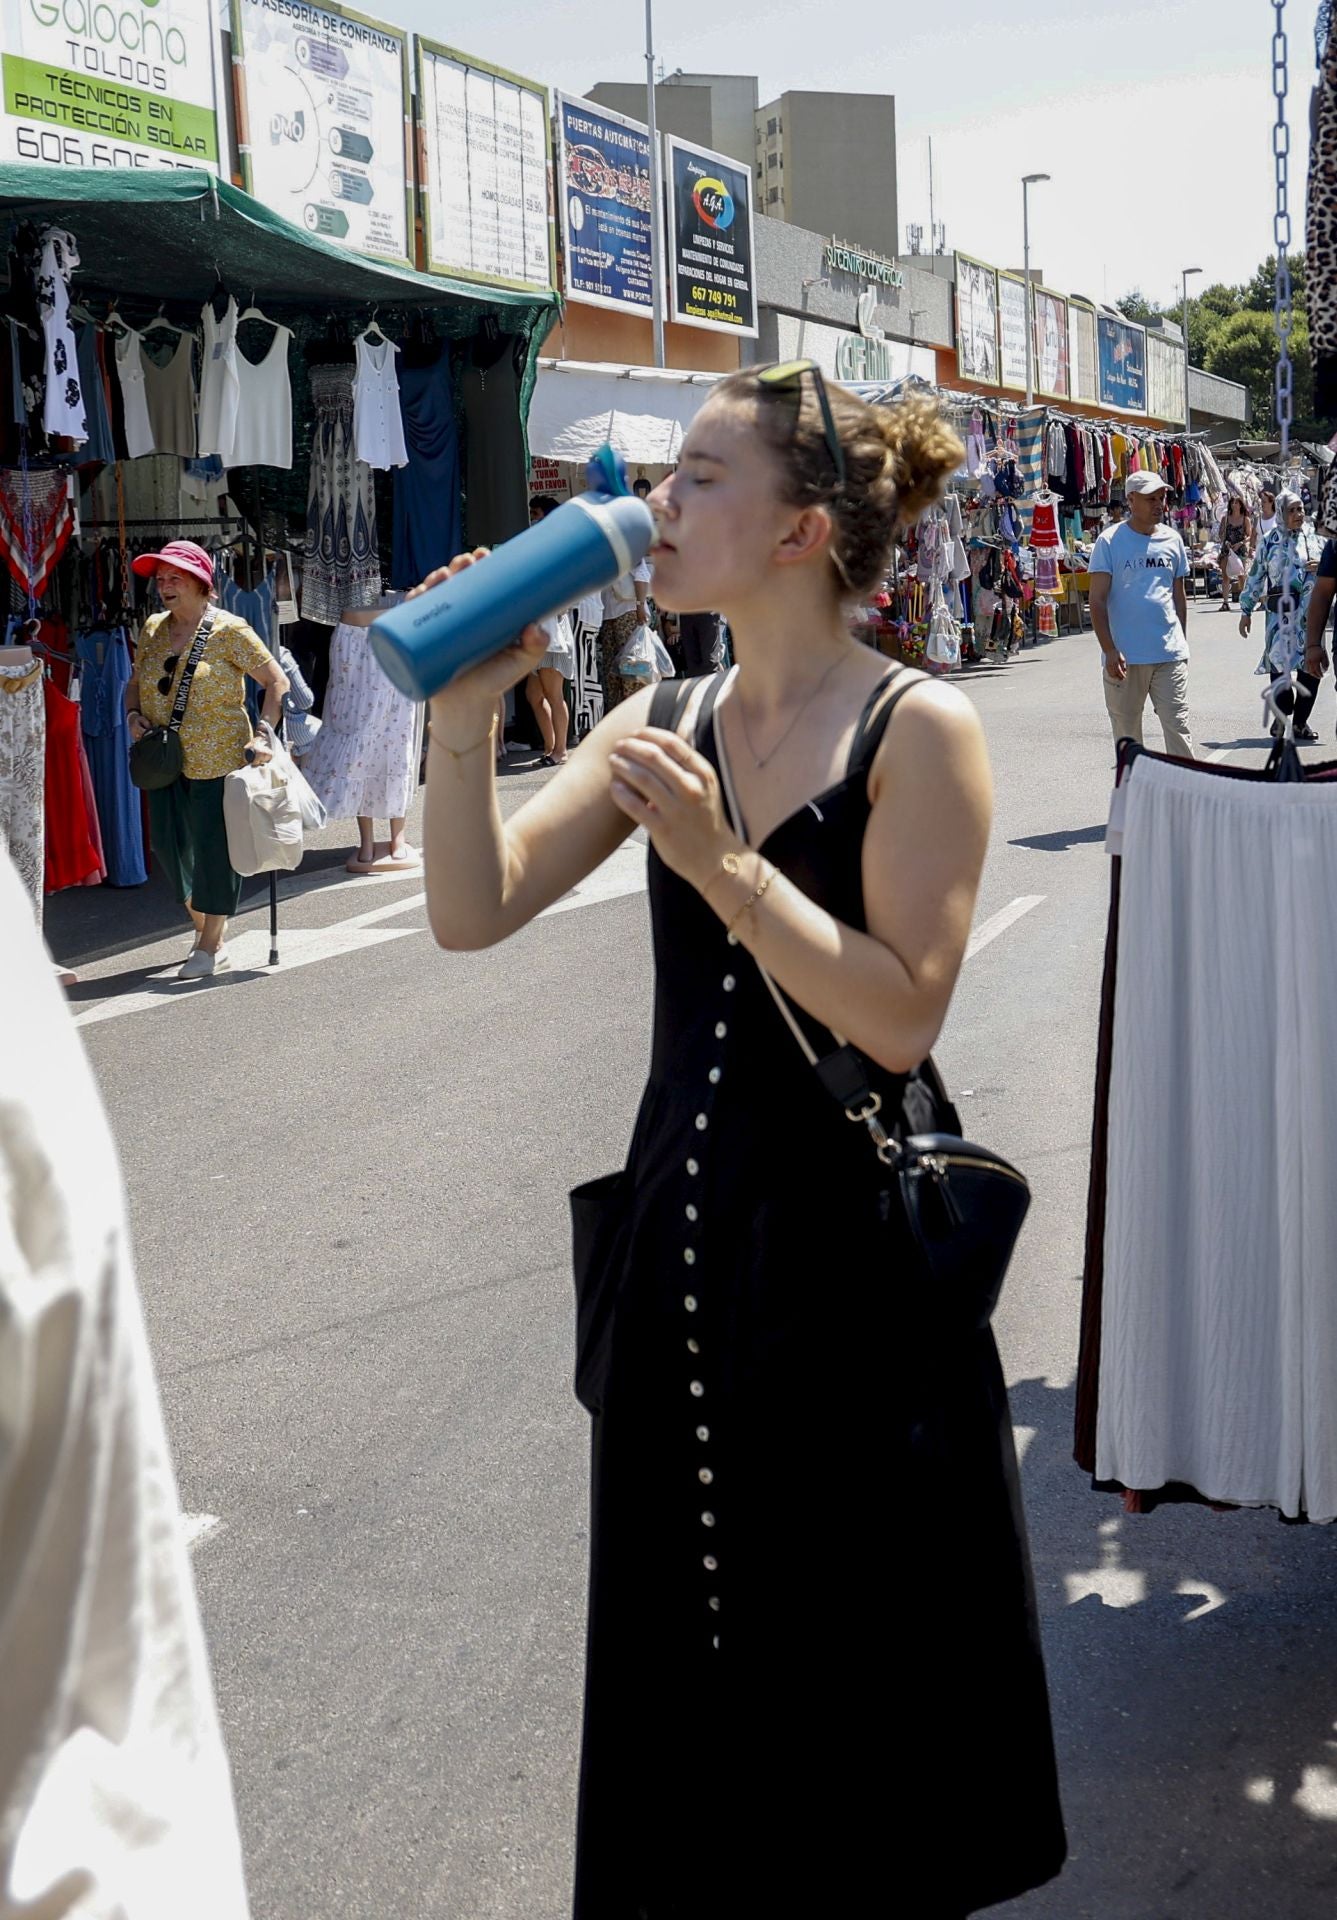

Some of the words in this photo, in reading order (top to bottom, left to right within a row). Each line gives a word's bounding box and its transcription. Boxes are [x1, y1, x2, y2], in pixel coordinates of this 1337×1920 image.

[261, 0, 320, 28] ASESORÍA
[322, 14, 337, 33] DE
[339, 21, 398, 55] CONFIANZA
[65, 40, 166, 90] TOLDOS
[45, 73, 141, 113] TÉCNICOS
[149, 101, 173, 122] EN
[15, 92, 140, 137] PROTECCIÓN
[147, 125, 207, 154] SOLAR
[567, 115, 603, 139] PUERTAS
[713, 256, 719, 267] DE
[705, 270, 713, 282] DEL
[727, 277, 733, 287] EN
[692, 285, 707, 301] 667
[707, 289, 722, 305] 749
[723, 293, 737, 308] 791
[529, 480, 544, 491] POR
[544, 479, 567, 490] FAVOR
[535, 468, 559, 479] TURNO
[188, 626, 210, 666] BIMBAY
[174, 671, 193, 712] BIMBAY
